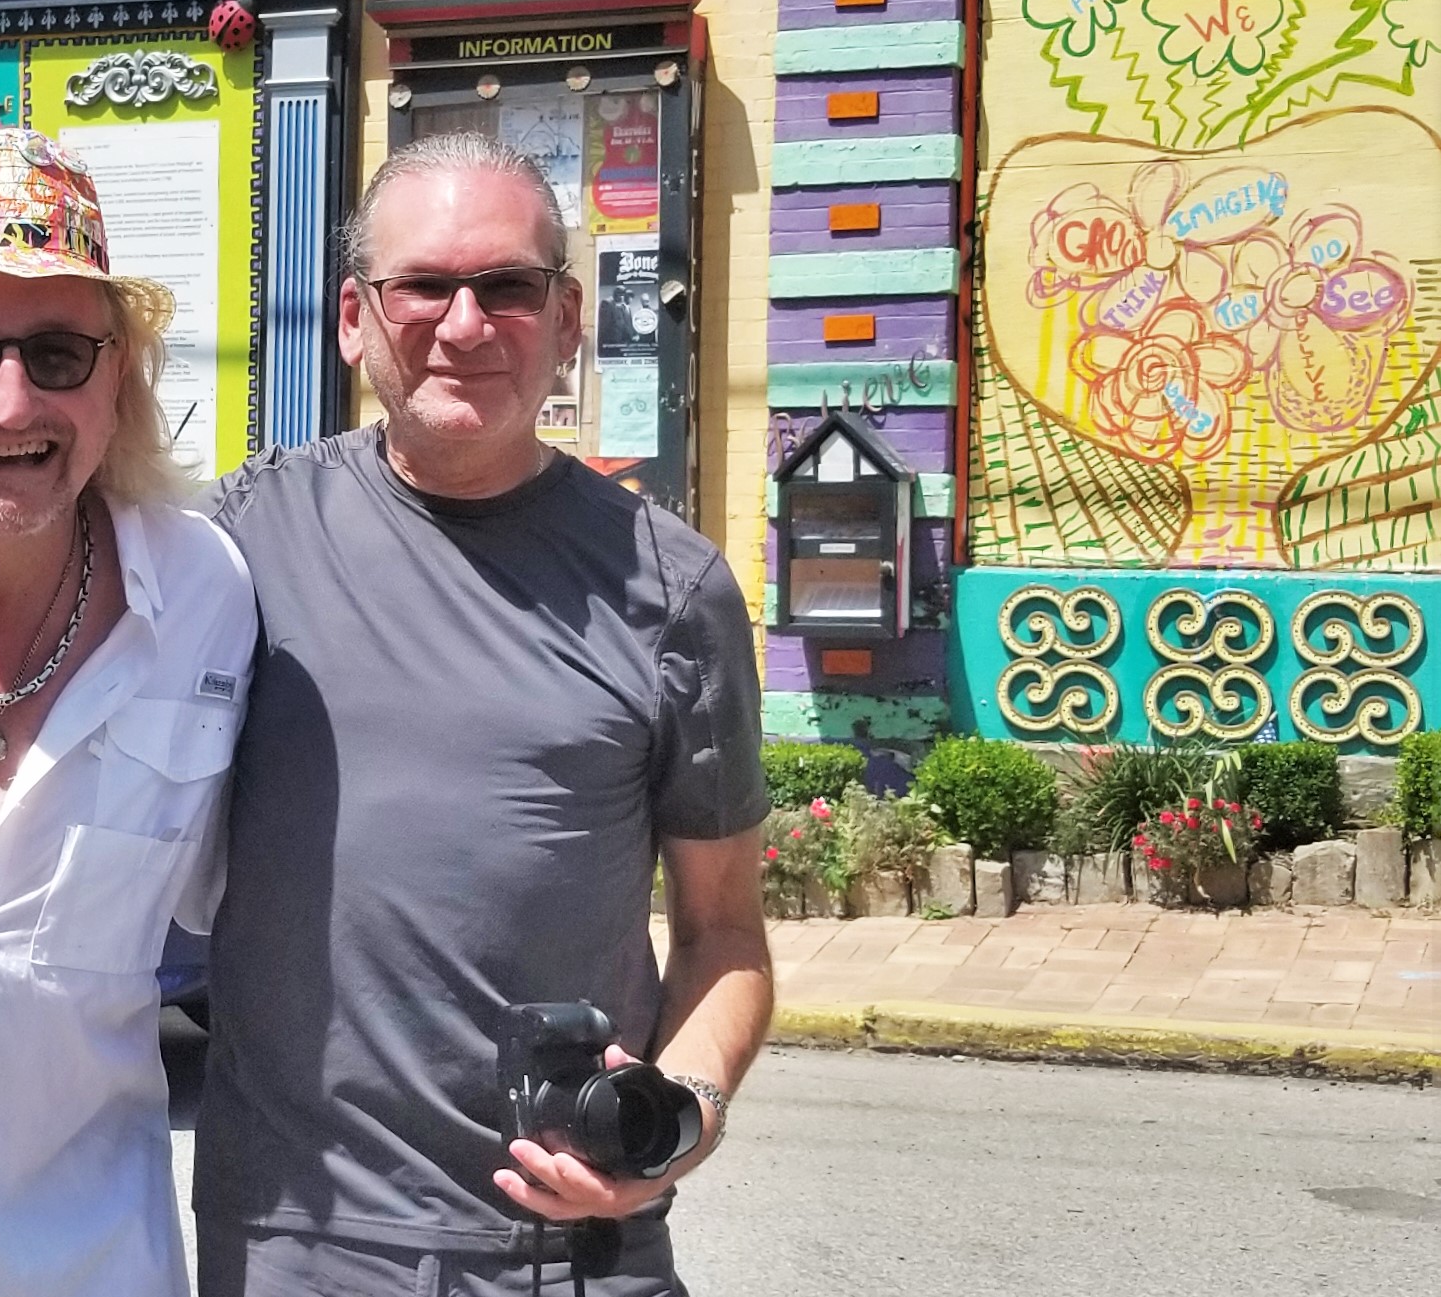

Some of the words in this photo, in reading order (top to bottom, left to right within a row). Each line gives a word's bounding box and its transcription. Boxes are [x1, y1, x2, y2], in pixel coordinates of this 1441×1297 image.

[458, 32, 613, 59] INFORMATION
[3, 95, 15, 112] E
[1167, 171, 1289, 239] IMAGINE
[1311, 239, 1343, 264] DO
[1103, 269, 1169, 331] THINK
[1216, 294, 1258, 329] TRY
[1322, 277, 1395, 315] See
